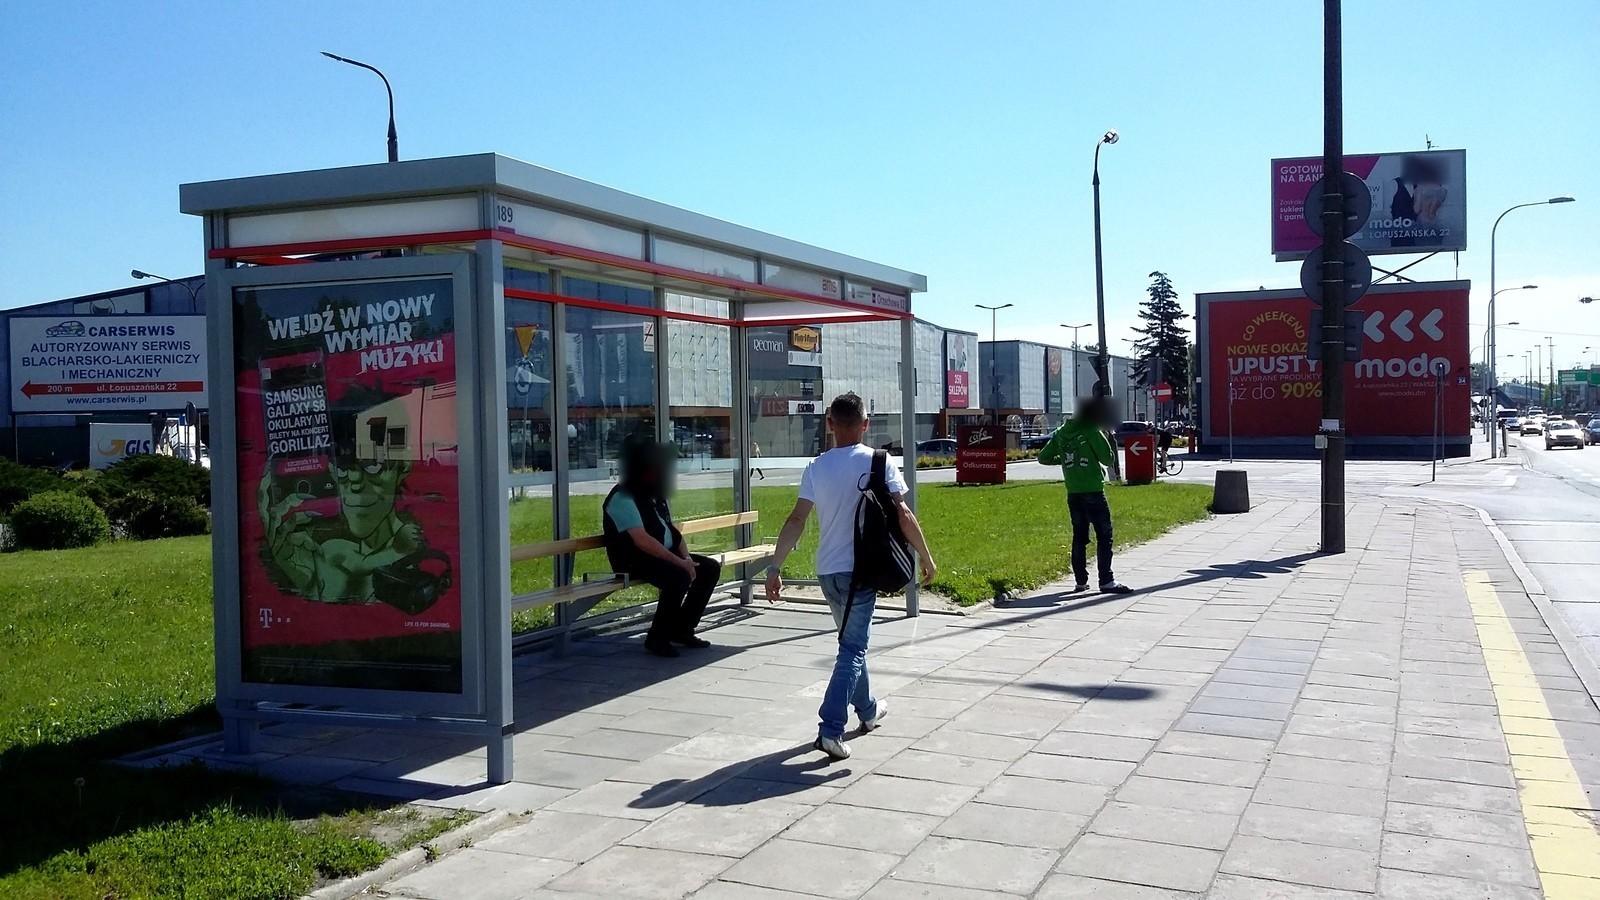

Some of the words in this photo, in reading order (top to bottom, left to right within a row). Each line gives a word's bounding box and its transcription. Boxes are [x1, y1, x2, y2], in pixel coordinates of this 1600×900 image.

[1280, 165, 1322, 175] GOTOWI
[1280, 174, 1296, 183] NA
[497, 204, 513, 223] 189
[1369, 216, 1412, 229] modo
[268, 304, 336, 341] WEJDŹ
[339, 306, 361, 329] W
[366, 295, 435, 325] NOWY
[1252, 311, 1305, 339] WEEKEND
[88, 325, 176, 337] CARSERWIS
[325, 321, 413, 353] WYMIAR
[1242, 325, 1255, 341] CO
[30, 341, 138, 353] AUTORYZOWANY
[142, 340, 191, 351] SERWIS
[1227, 344, 1268, 355] NOWE
[22, 353, 200, 367] BLACHARSKO-LAKIERNICZY
[358, 340, 444, 374] MUZYKI
[1227, 355, 1319, 375] UPUSTY
[68, 368, 162, 379] MECHANICZNY
[1355, 353, 1451, 378] modo
[47, 385, 63, 393] 200
[96, 384, 107, 392] ul.
[109, 383, 165, 393] Łopuszańska
[167, 382, 177, 391] 22
[265, 384, 325, 406] SAMSUNG
[1251, 383, 1275, 400] do
[1281, 382, 1323, 399] 90%
[66, 394, 147, 405] www.carserwis.pl
[267, 401, 310, 419] GALAXY
[312, 399, 326, 412] S8
[267, 415, 312, 431] OKULARY
[314, 413, 328, 425] VR
[301, 425, 329, 436] KONCERT
[270, 434, 331, 454] GORILLAZ
[963, 450, 997, 458] Kompresor
